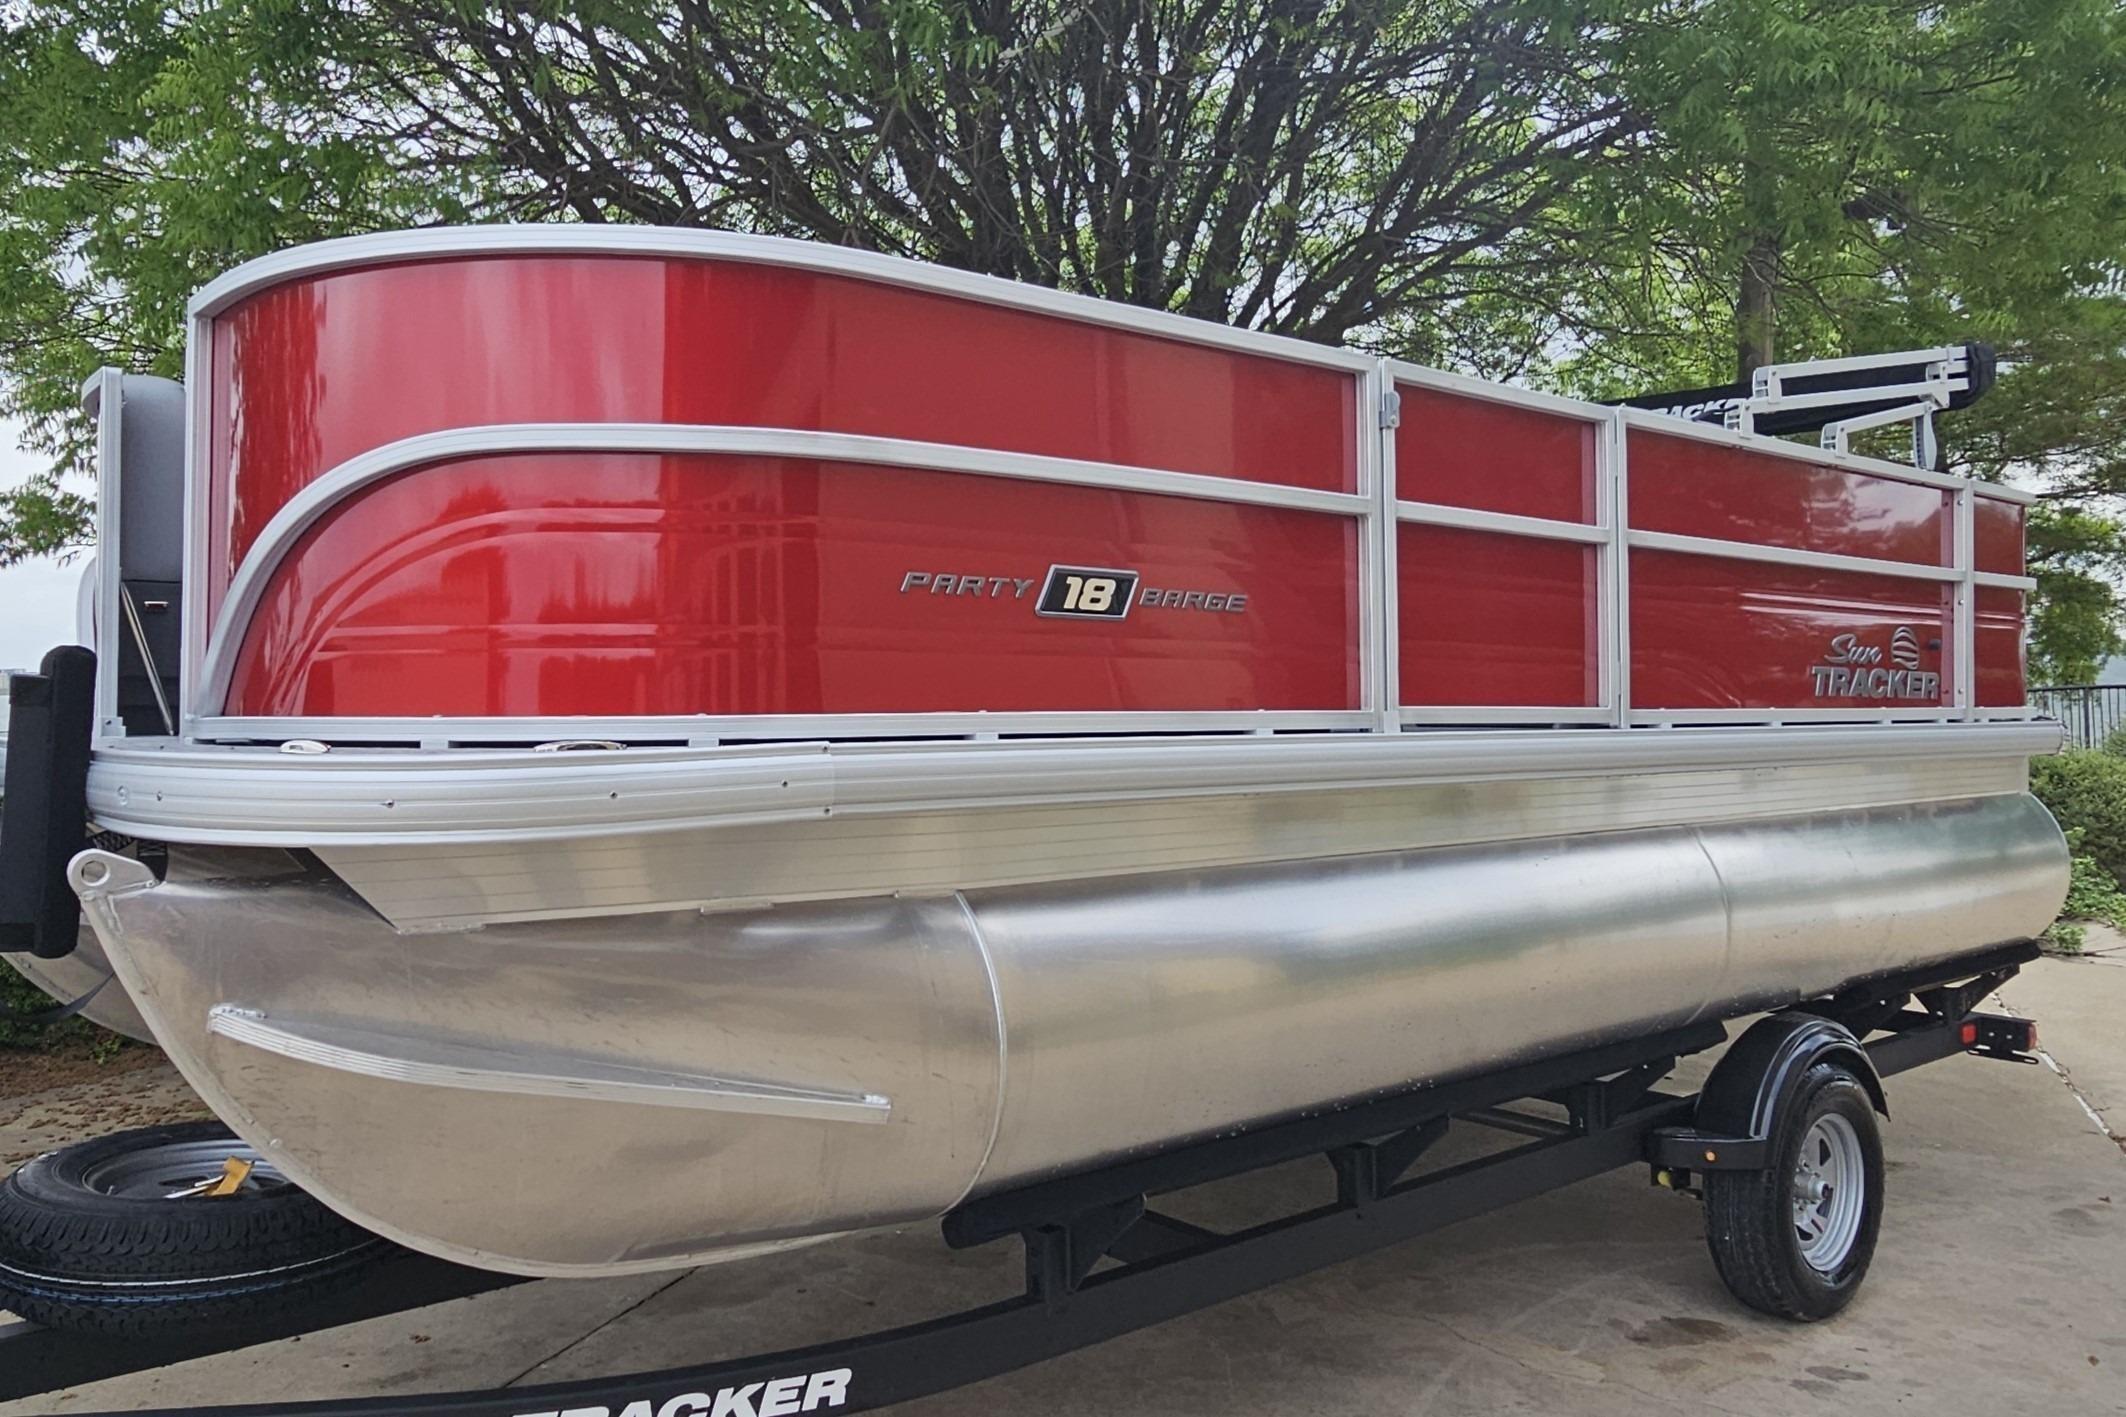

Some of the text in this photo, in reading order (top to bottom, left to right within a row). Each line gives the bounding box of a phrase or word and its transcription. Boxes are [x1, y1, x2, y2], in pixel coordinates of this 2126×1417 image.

[900, 571, 1249, 613] PARTY 18 BARGE
[1824, 633, 1882, 665] Sun
[1812, 665, 1940, 699] TRACKER
